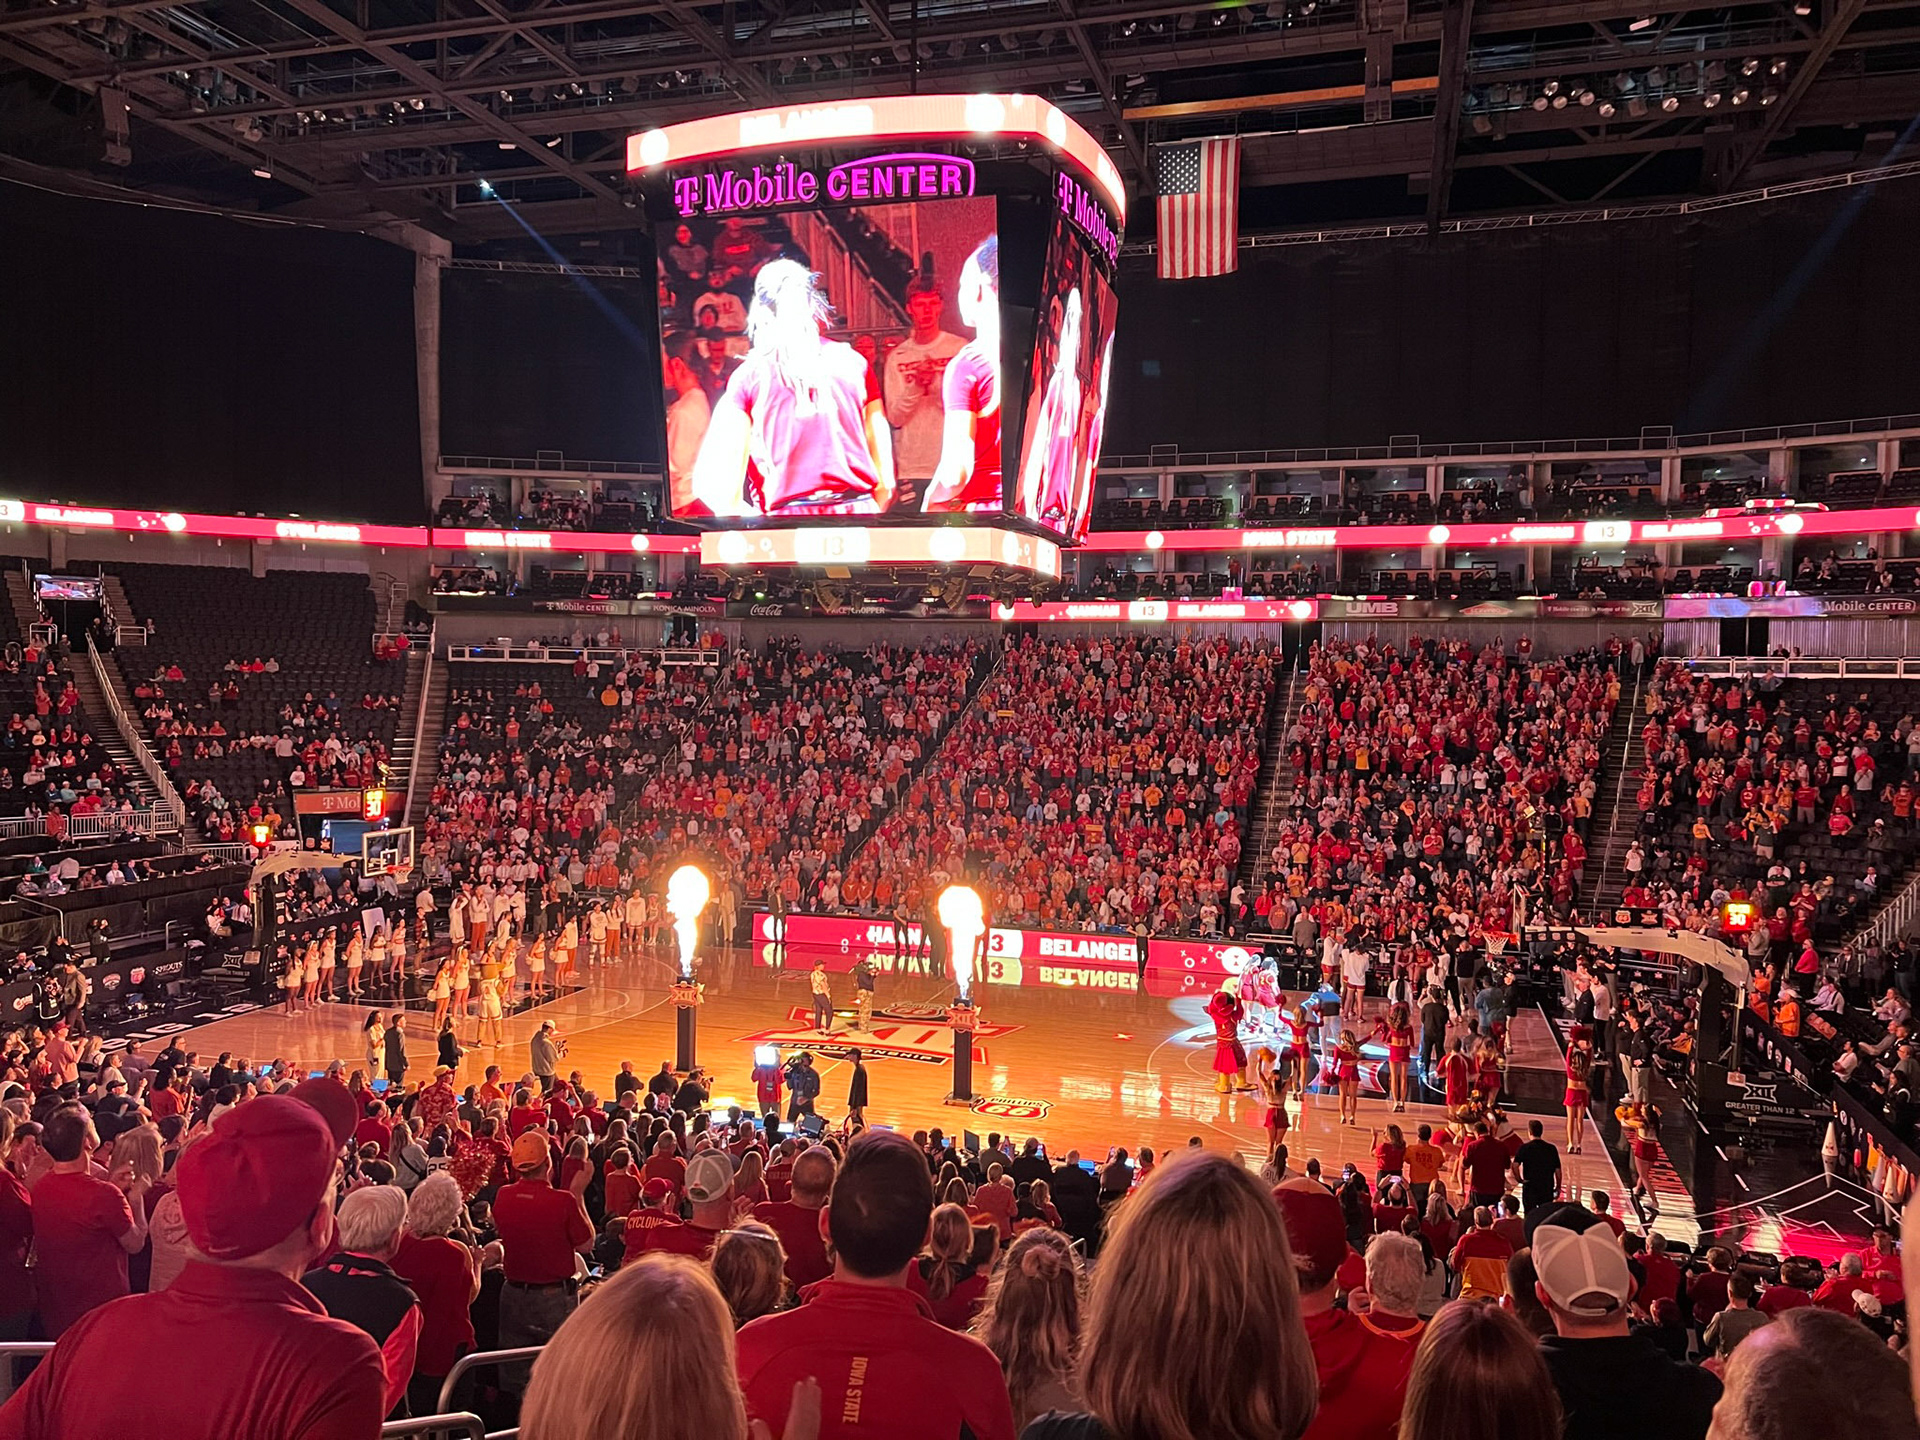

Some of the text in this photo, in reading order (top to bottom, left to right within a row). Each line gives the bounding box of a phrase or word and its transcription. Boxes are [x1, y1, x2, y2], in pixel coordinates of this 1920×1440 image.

[704, 162, 817, 211] Mobile
[826, 164, 963, 199] CENTER
[1601, 526, 1616, 538] 13
[822, 536, 845, 556] 13
[556, 601, 585, 611] Mobile
[585, 604, 616, 612] CENTER
[653, 604, 683, 612] KONICA
[684, 605, 717, 613] MINOLTA
[1142, 605, 1156, 616] 13
[1346, 602, 1399, 615] UMB
[1824, 600, 1866, 611] Mobile
[1867, 601, 1912, 611] CENTER
[366, 800, 382, 817] 30
[1729, 913, 1746, 926] 30
[990, 934, 1004, 952] 3
[781, 1043, 934, 1061] CHAMPONSHIP
[984, 1103, 1035, 1117] 66
[1725, 1101, 1795, 1115] GREATER THAN 12
[842, 1356, 869, 1424] IOWA STATE
